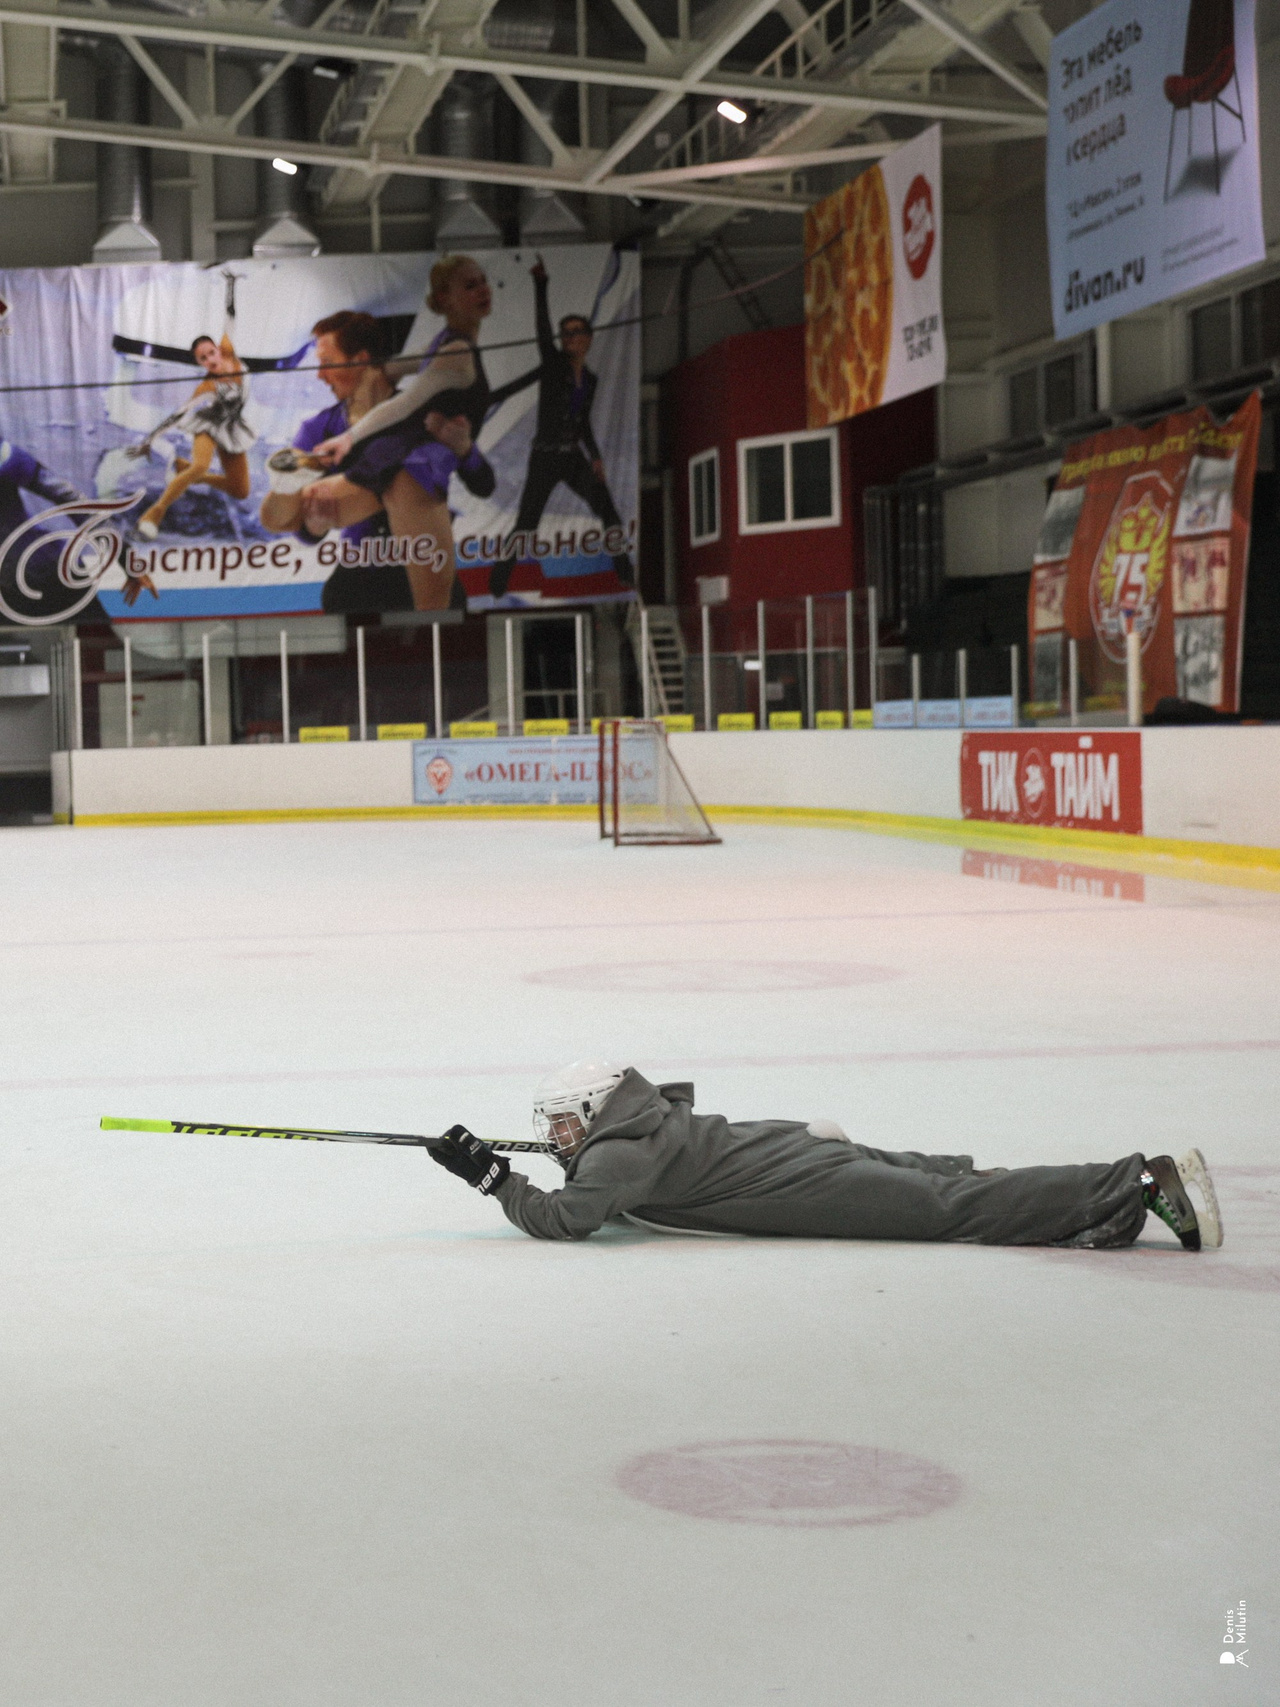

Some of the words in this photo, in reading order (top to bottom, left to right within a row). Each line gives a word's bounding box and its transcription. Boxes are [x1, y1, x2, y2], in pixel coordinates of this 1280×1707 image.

[1065, 256, 1146, 313] divan.ru
[316, 532, 448, 573] выше,
[456, 518, 637, 563] сильнее!
[977, 751, 1020, 813] ТИК
[1050, 735, 1120, 822] ТАЙМ
